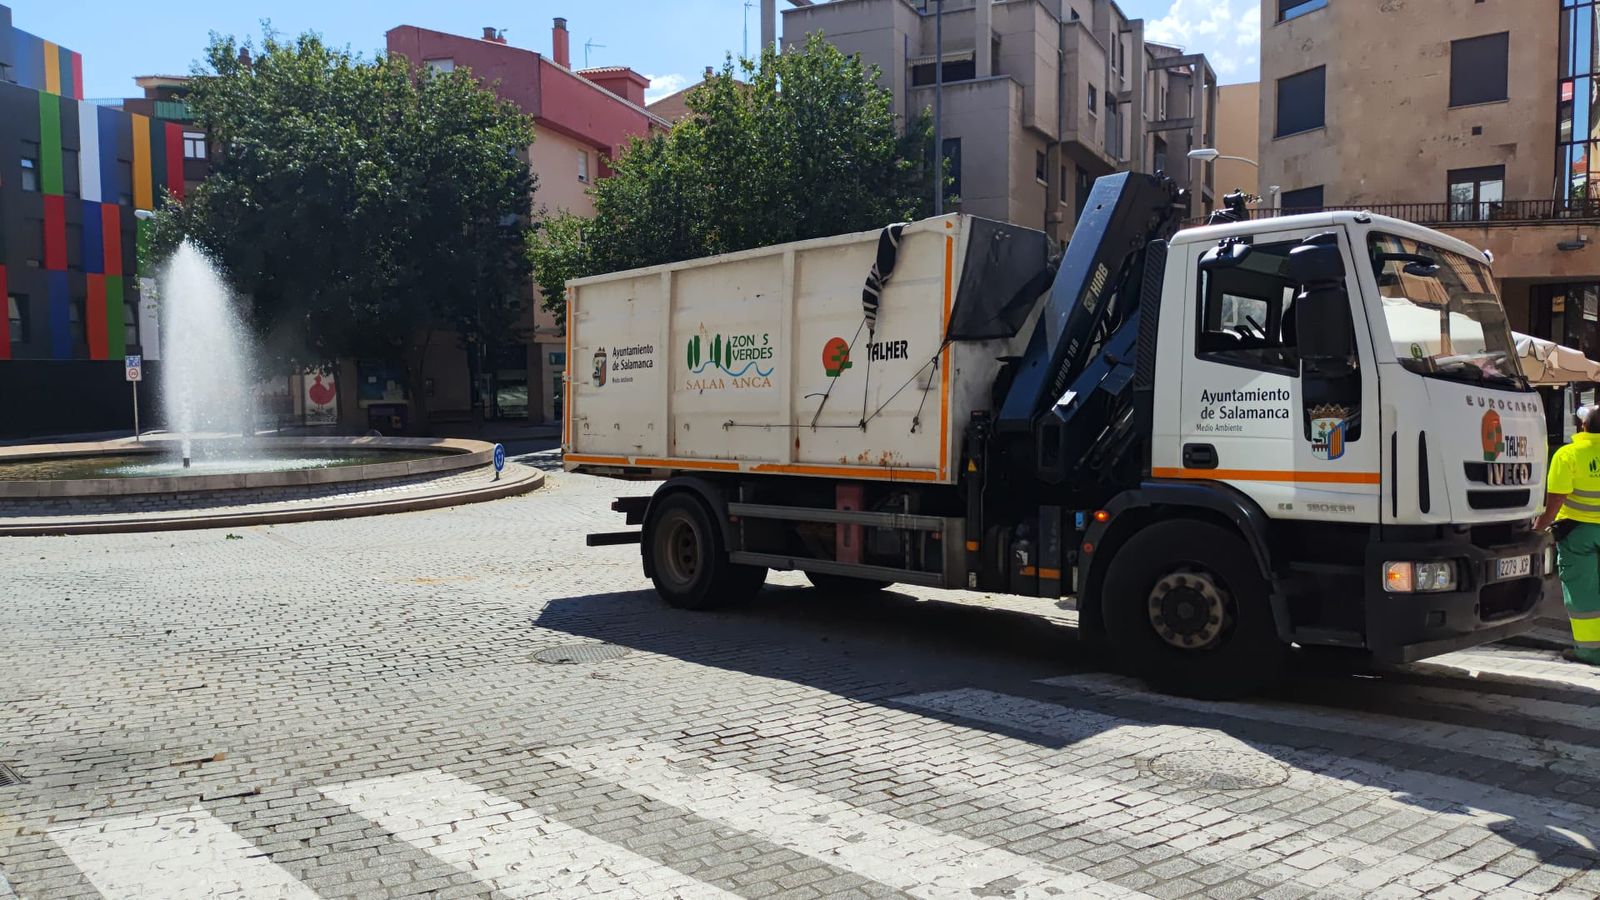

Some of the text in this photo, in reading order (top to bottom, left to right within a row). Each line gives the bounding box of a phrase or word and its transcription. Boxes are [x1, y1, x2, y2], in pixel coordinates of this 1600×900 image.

[1090, 262, 1109, 297] HIAB
[732, 334, 769, 347] ZONS
[612, 344, 654, 359] Ayuntamiento
[732, 347, 773, 361] VERDES
[866, 340, 908, 362] TALHER
[612, 359, 653, 371] de Salamanca
[1200, 388, 1290, 405] Ayuntamiento
[1200, 406, 1289, 419] de Salamanca
[1215, 424, 1243, 432] Ambiente
[1504, 436, 1528, 458] TALHER
[1487, 463, 1529, 485] IVECO
[1500, 560, 1517, 576] 2279
